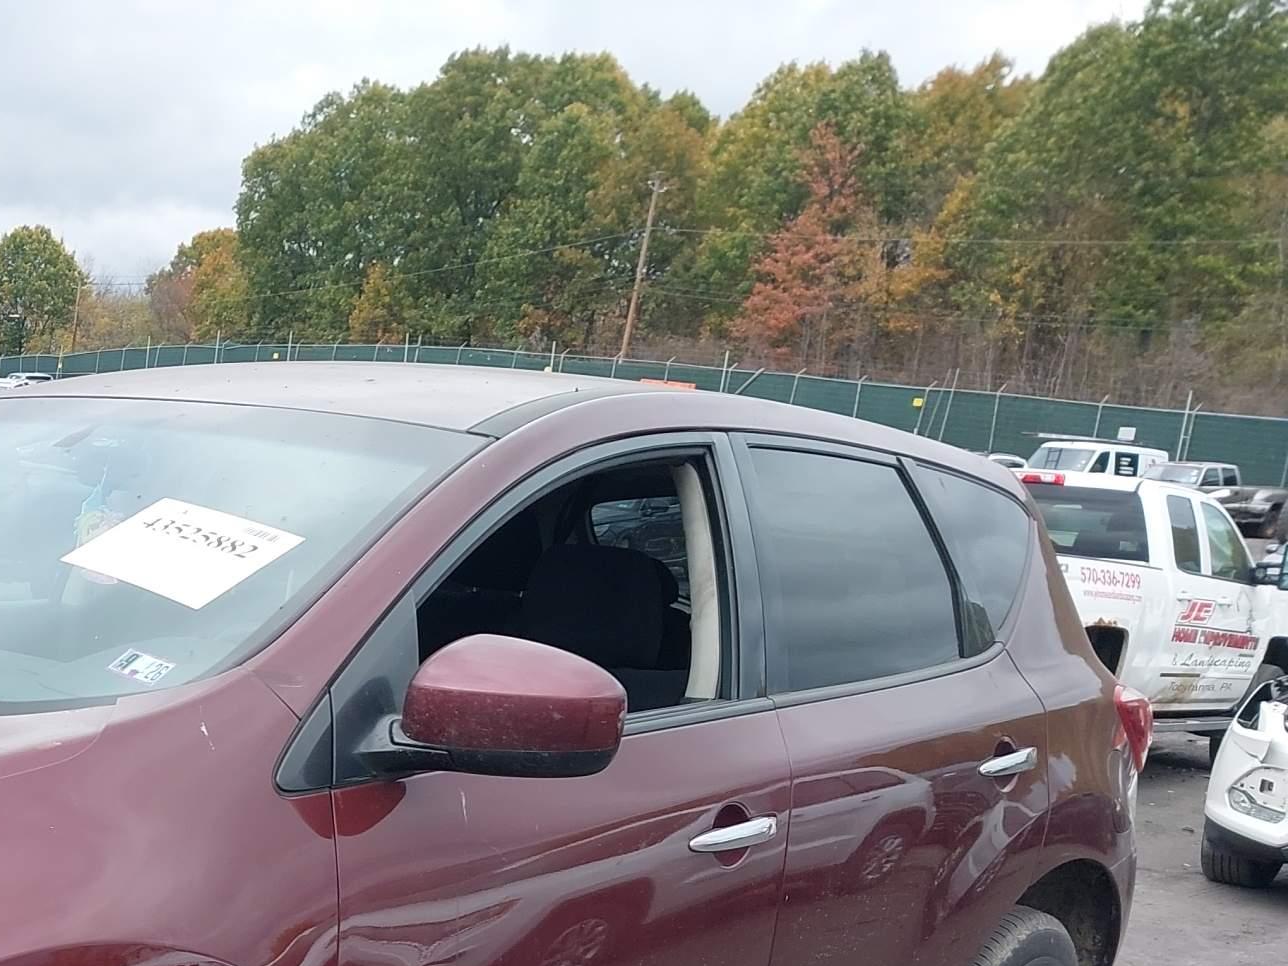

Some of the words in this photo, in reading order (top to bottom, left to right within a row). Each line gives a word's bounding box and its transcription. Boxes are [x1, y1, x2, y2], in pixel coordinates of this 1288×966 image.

[143, 518, 259, 558] 43525882
[1079, 566, 1141, 590] 570-336-7299
[1177, 600, 1215, 624] JE
